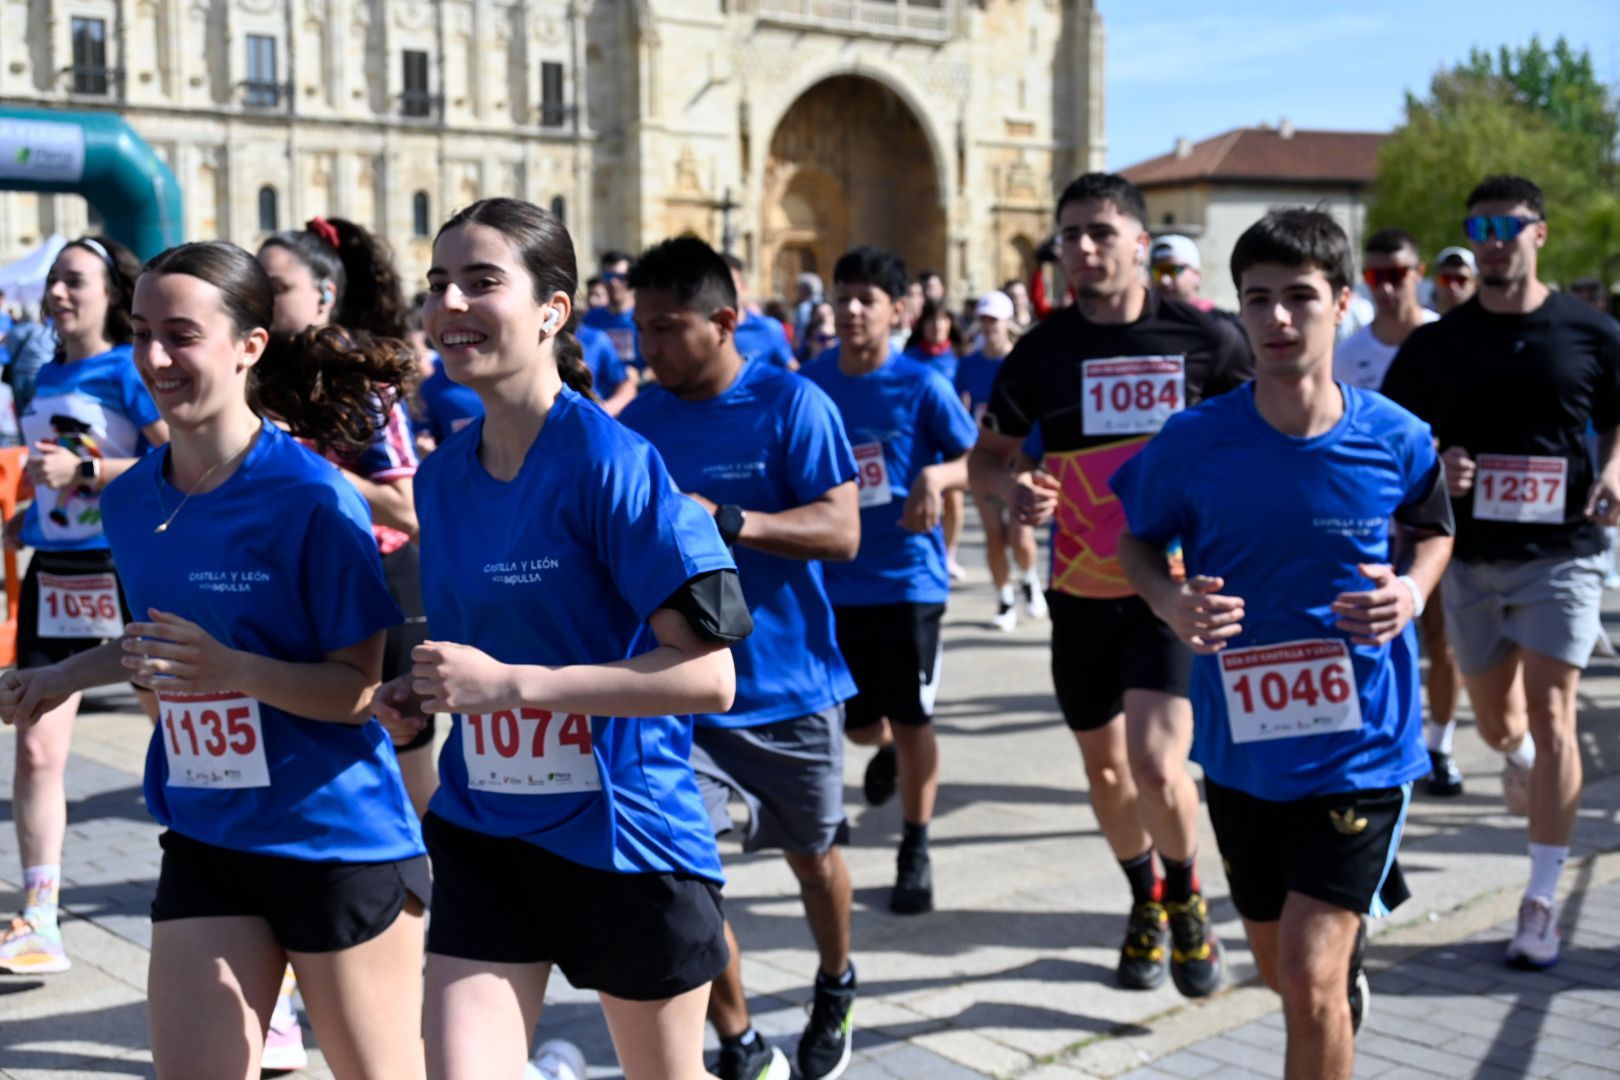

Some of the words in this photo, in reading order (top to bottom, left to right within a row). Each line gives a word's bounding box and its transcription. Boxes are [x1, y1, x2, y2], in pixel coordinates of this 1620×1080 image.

[1090, 380, 1178, 412] 1084
[1482, 475, 1560, 503] 1237
[230, 571, 238, 582] Y
[241, 570, 270, 581] LEÓN
[521, 561, 527, 572] Y
[530, 556, 559, 570] LEÓN
[46, 592, 116, 620] 1056
[1233, 664, 1350, 714] 1046
[166, 706, 256, 757] 1135
[468, 708, 592, 758] 1074
